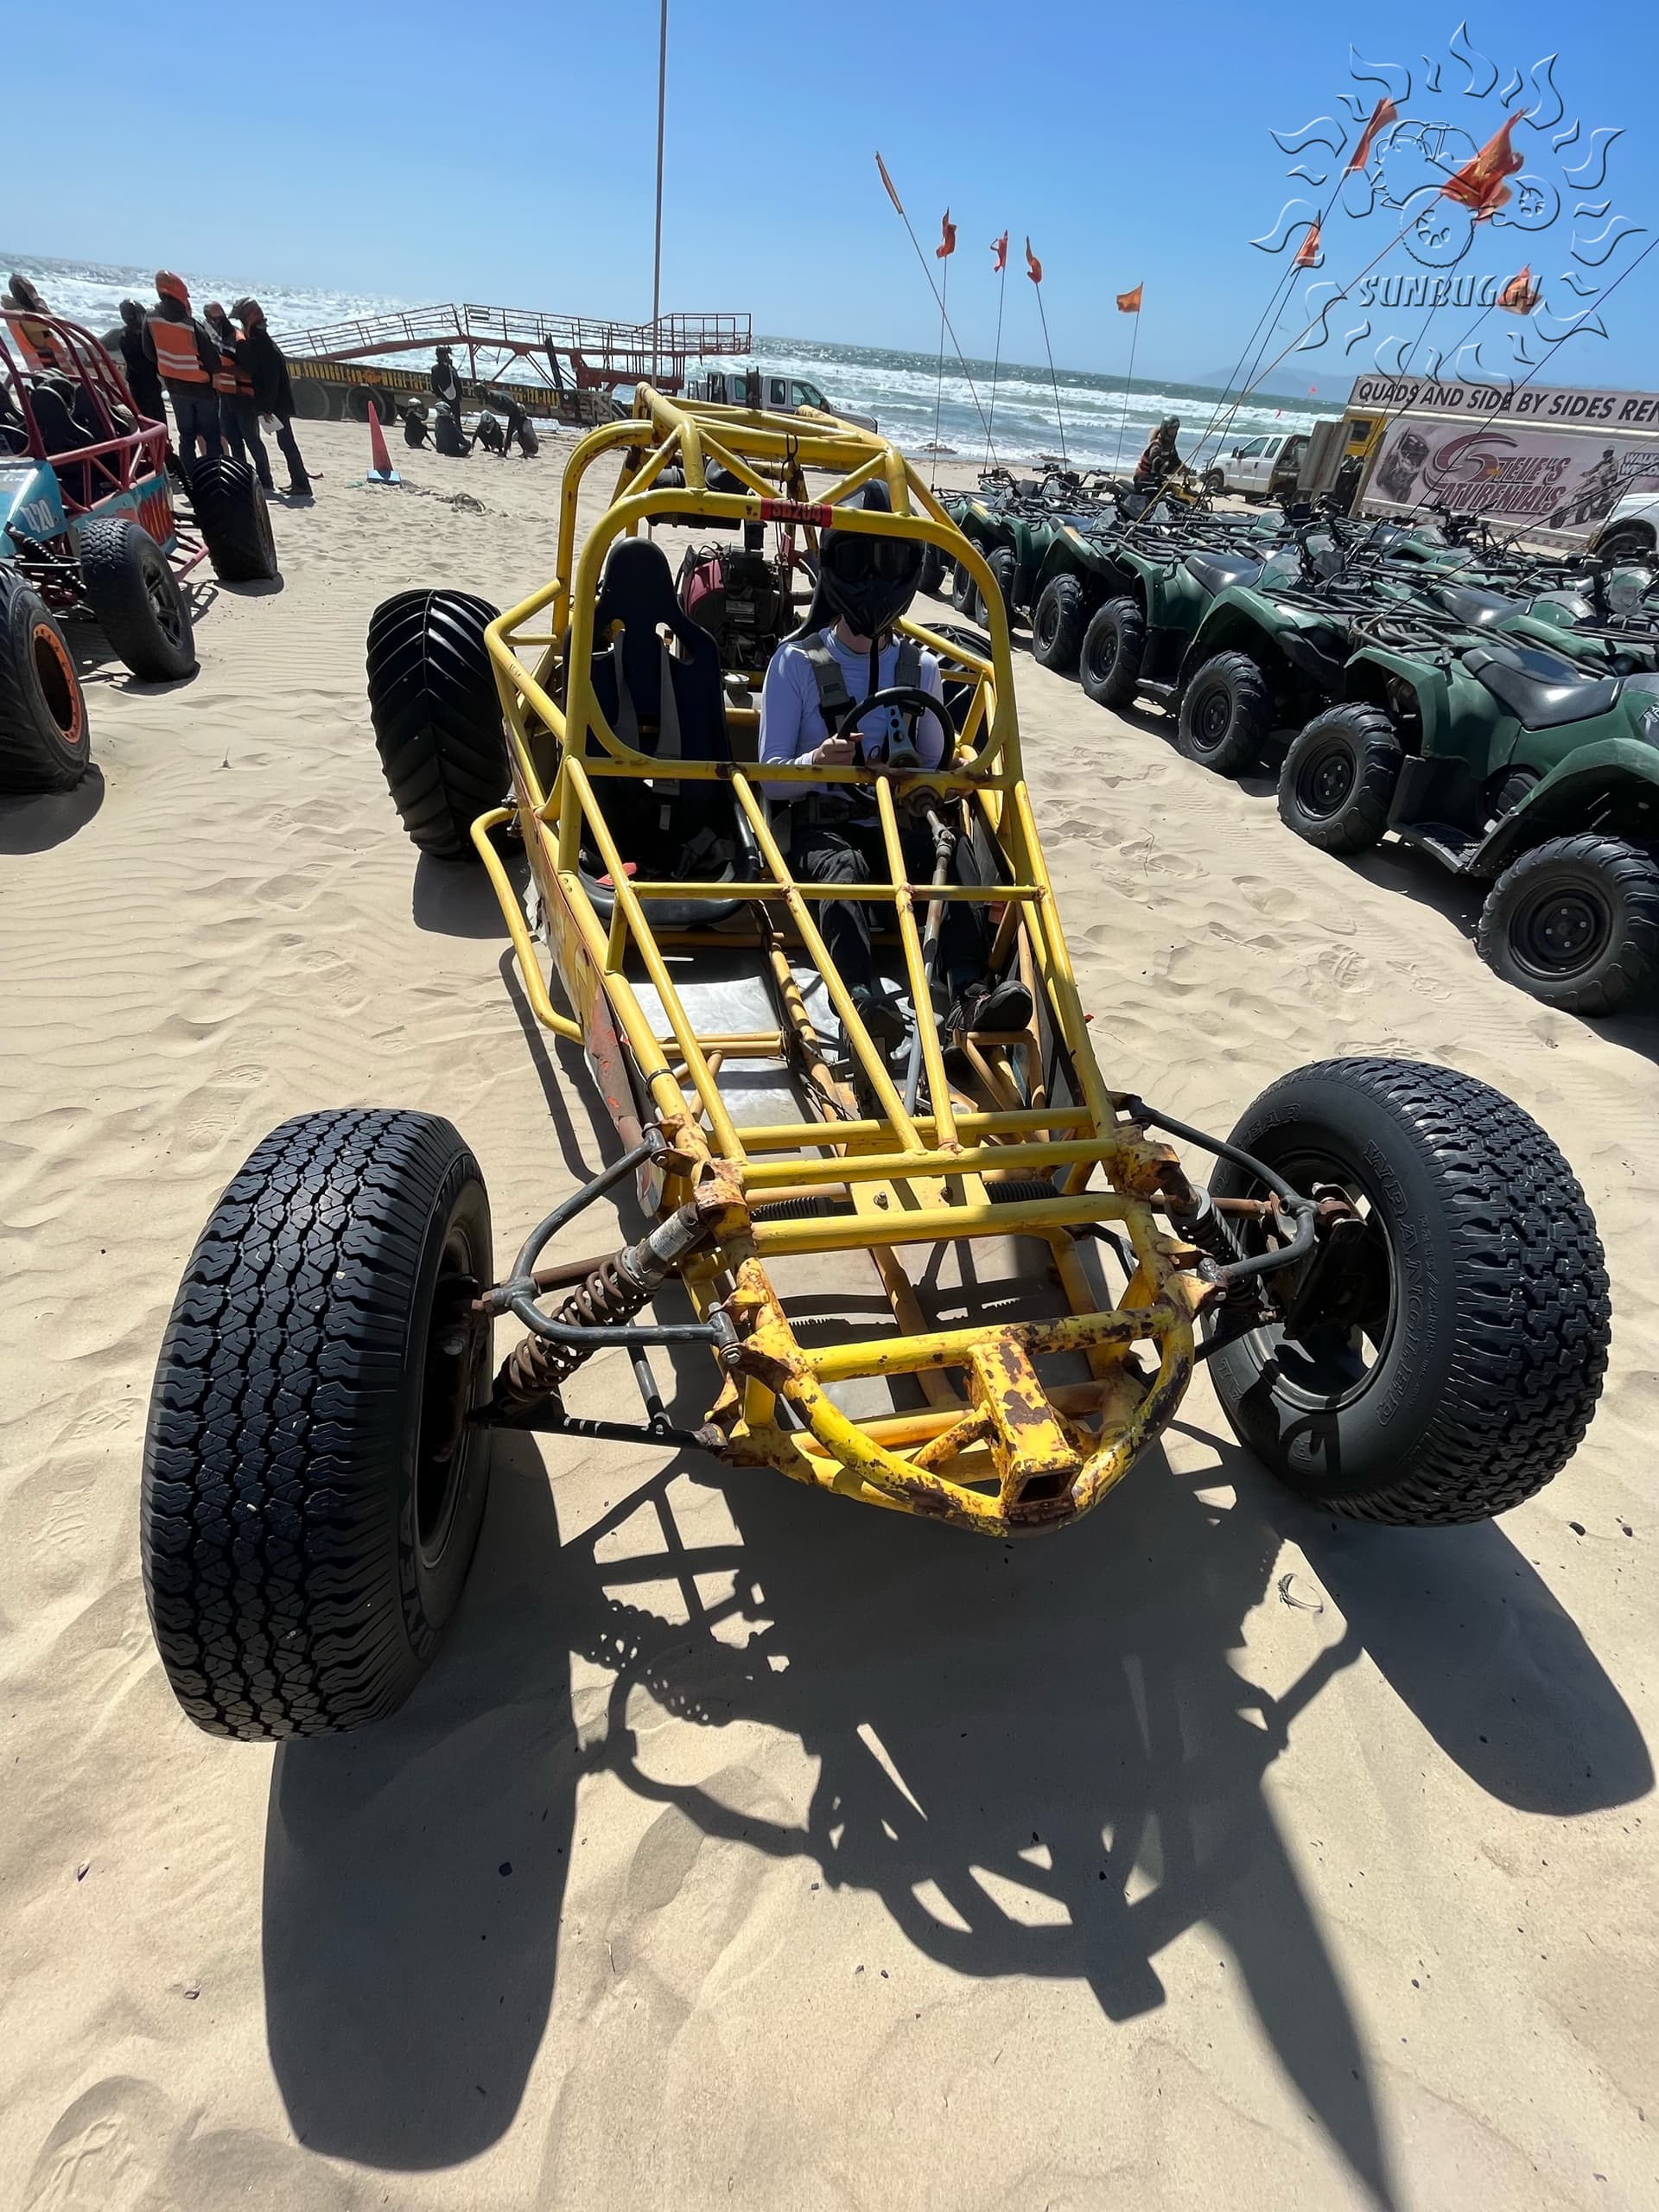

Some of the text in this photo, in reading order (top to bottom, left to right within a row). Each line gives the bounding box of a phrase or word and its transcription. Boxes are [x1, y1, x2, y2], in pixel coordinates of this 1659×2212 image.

[1358, 382, 1420, 404] QUADS
[1420, 385, 1464, 408] AND
[1467, 389, 1514, 411] SIDE
[1516, 392, 1548, 414] BY
[1548, 394, 1617, 419] SIDES
